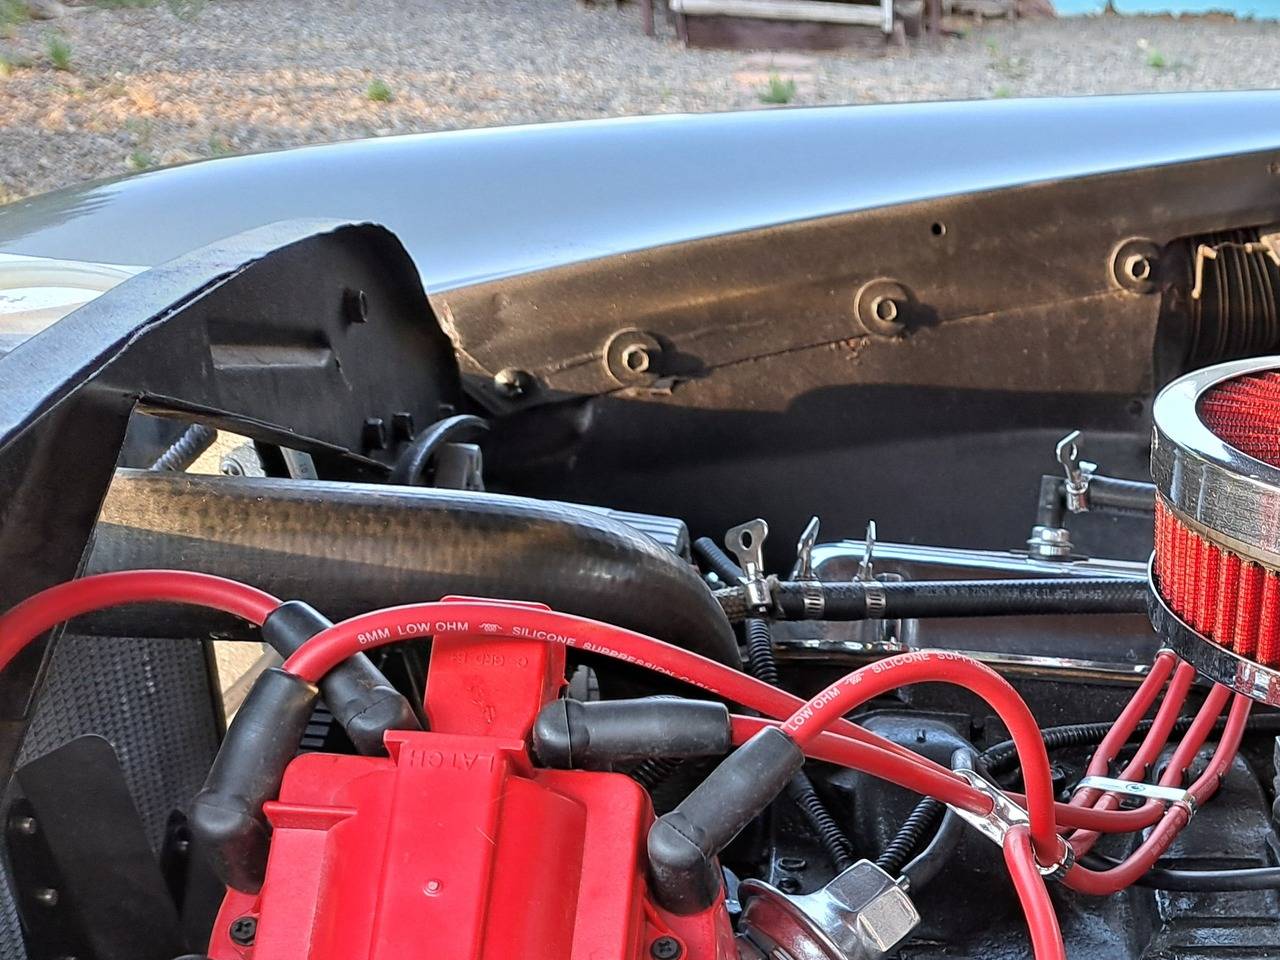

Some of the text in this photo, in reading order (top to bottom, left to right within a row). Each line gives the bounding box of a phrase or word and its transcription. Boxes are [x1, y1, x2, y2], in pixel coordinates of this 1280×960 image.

[357, 628, 391, 646] 8MM
[397, 622, 431, 636] LOW
[435, 621, 470, 633] OHM
[511, 625, 577, 647] SILICONE
[788, 707, 814, 732] LOW
[814, 687, 841, 710] OHM
[871, 653, 930, 675] SILICONE
